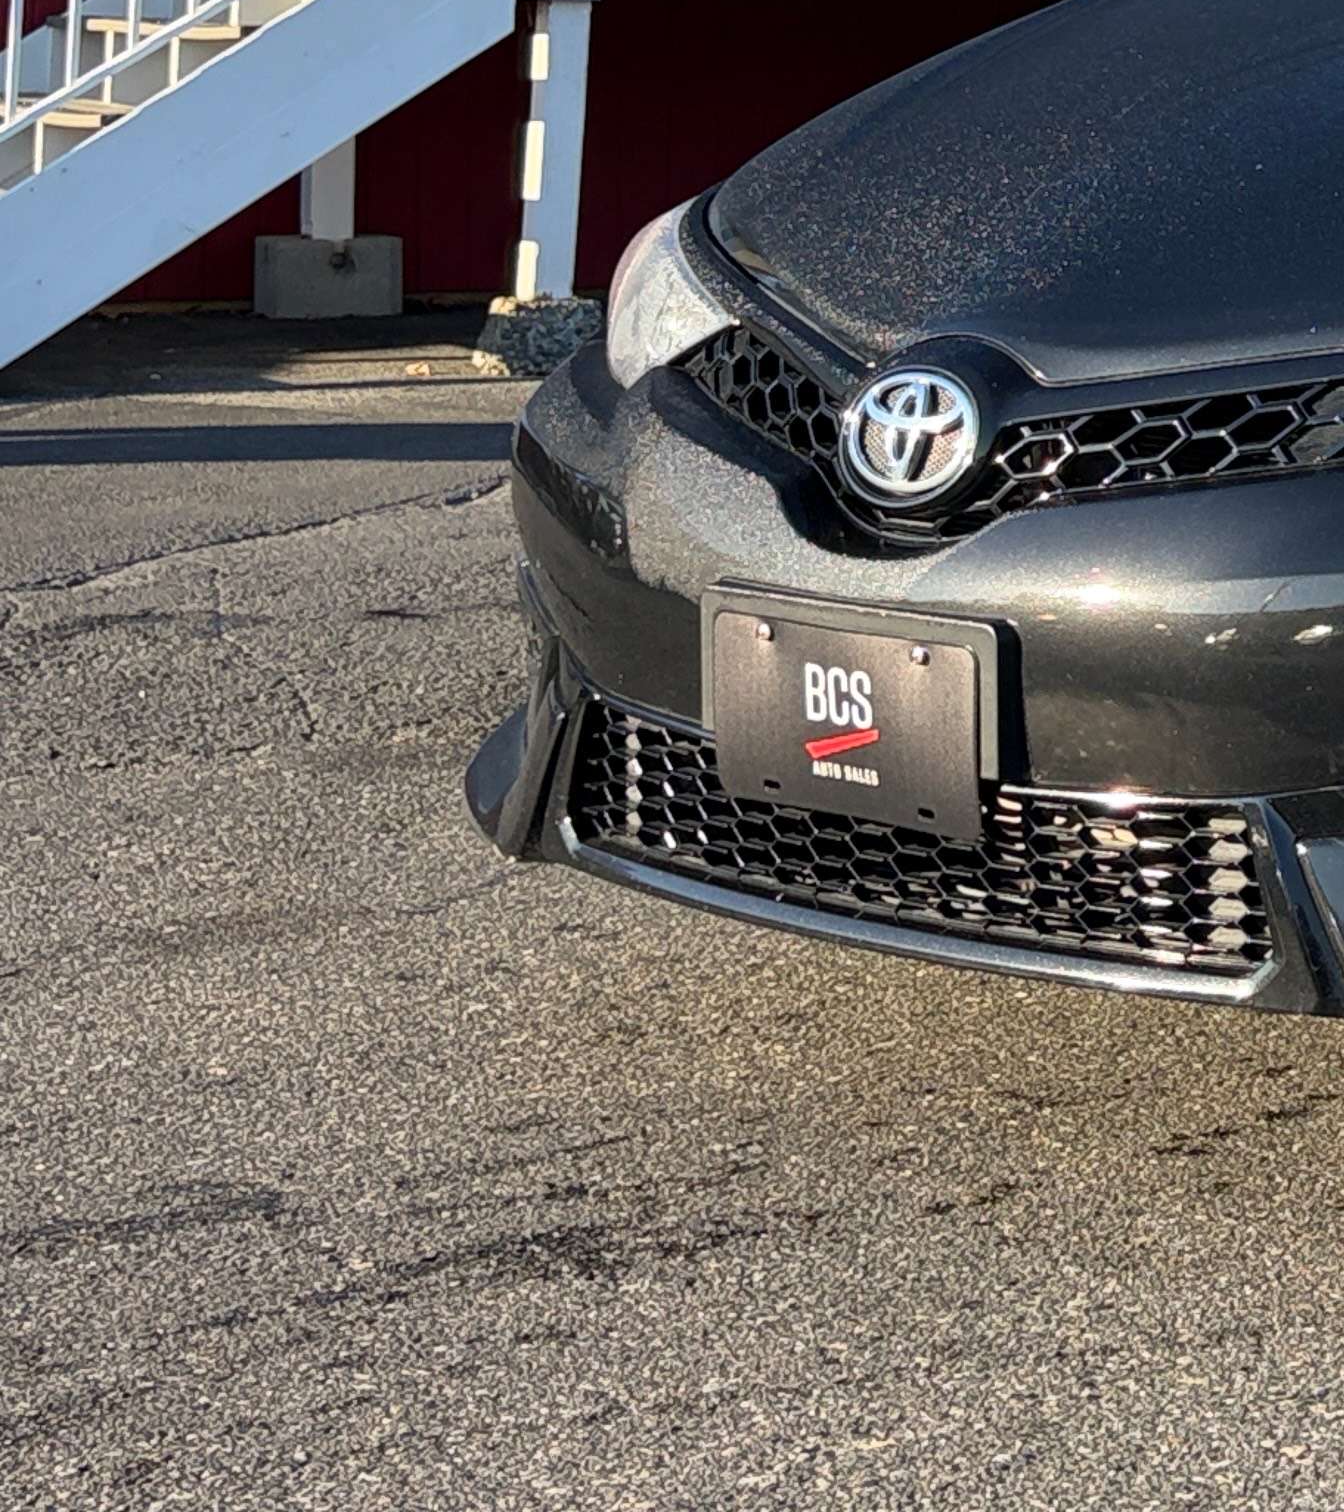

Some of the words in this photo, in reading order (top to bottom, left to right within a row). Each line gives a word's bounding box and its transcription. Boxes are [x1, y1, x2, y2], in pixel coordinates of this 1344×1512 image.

[804, 662, 873, 729] BCS
[812, 759, 842, 780] AUTO
[843, 764, 880, 787] SALES
